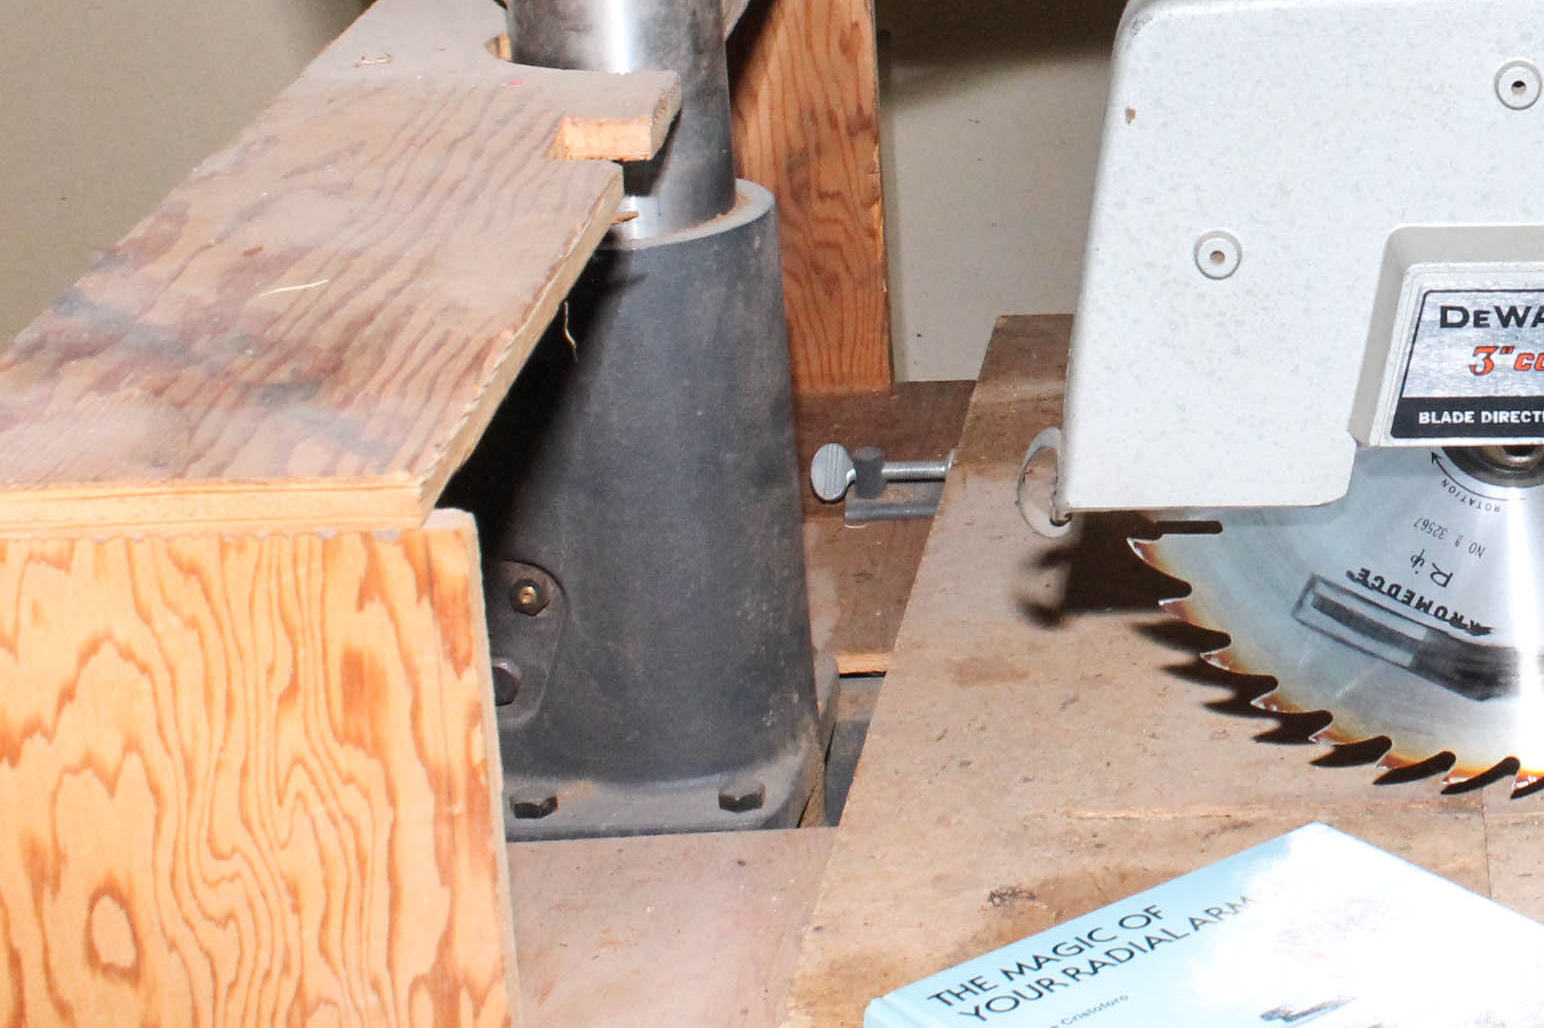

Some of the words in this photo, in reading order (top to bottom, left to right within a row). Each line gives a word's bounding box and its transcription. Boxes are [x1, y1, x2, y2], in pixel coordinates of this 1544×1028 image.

[1418, 410, 1475, 425] BLADE
[1441, 478, 1501, 513] ROTATION
[1413, 516, 1449, 540] 32567
[1410, 548, 1453, 588] Rip
[927, 975, 998, 1007] THE
[1000, 927, 1119, 982] MAGIC
[1118, 905, 1166, 930] OF
[959, 977, 1070, 1022] YOUR
[1061, 928, 1190, 983] RADIAL
[1188, 896, 1257, 932] ARM
